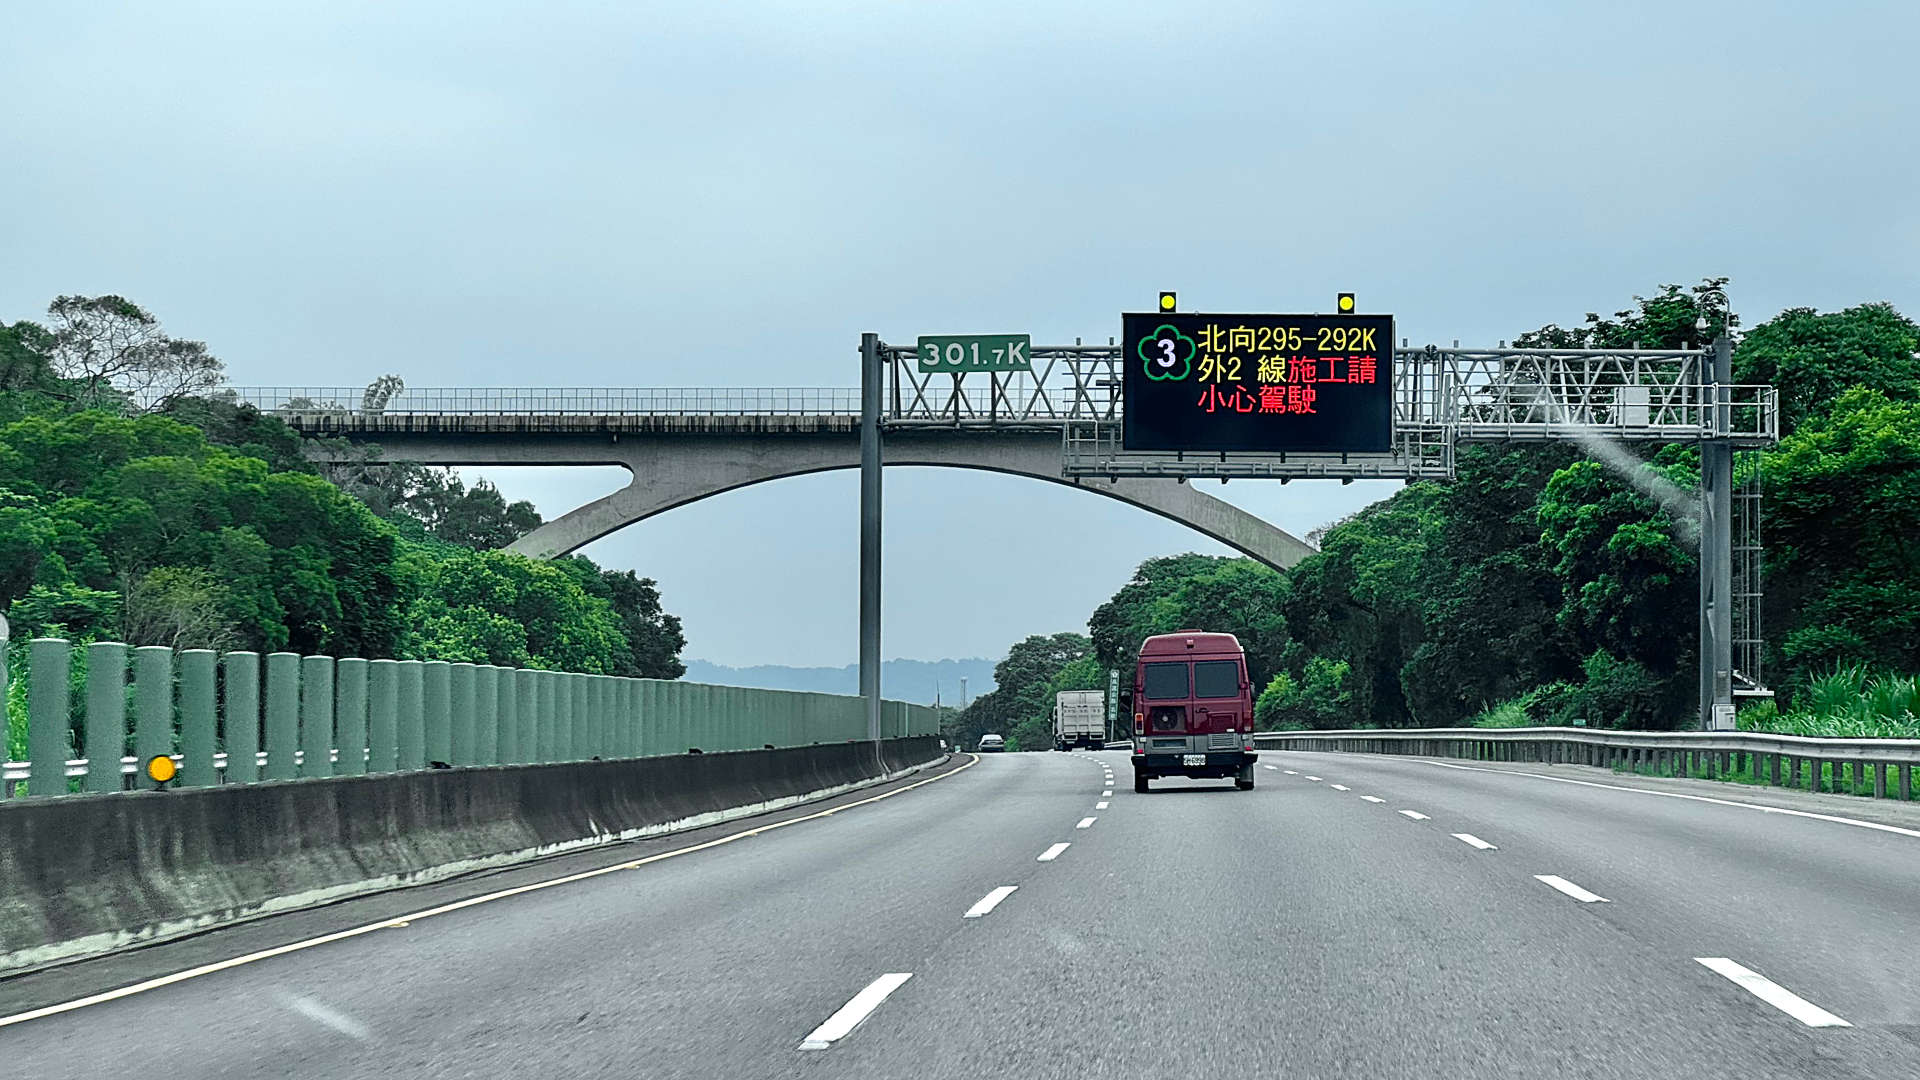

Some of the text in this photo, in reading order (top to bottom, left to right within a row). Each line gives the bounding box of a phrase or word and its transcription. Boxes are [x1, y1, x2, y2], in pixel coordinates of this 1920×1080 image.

[1156, 338, 1177, 368] 3
[1198, 324, 1376, 353] 北向295-292K
[922, 341, 1026, 366] 301.7K
[1198, 355, 1377, 384] 外2 線施工請
[1198, 384, 1317, 414] 小心駕駛
